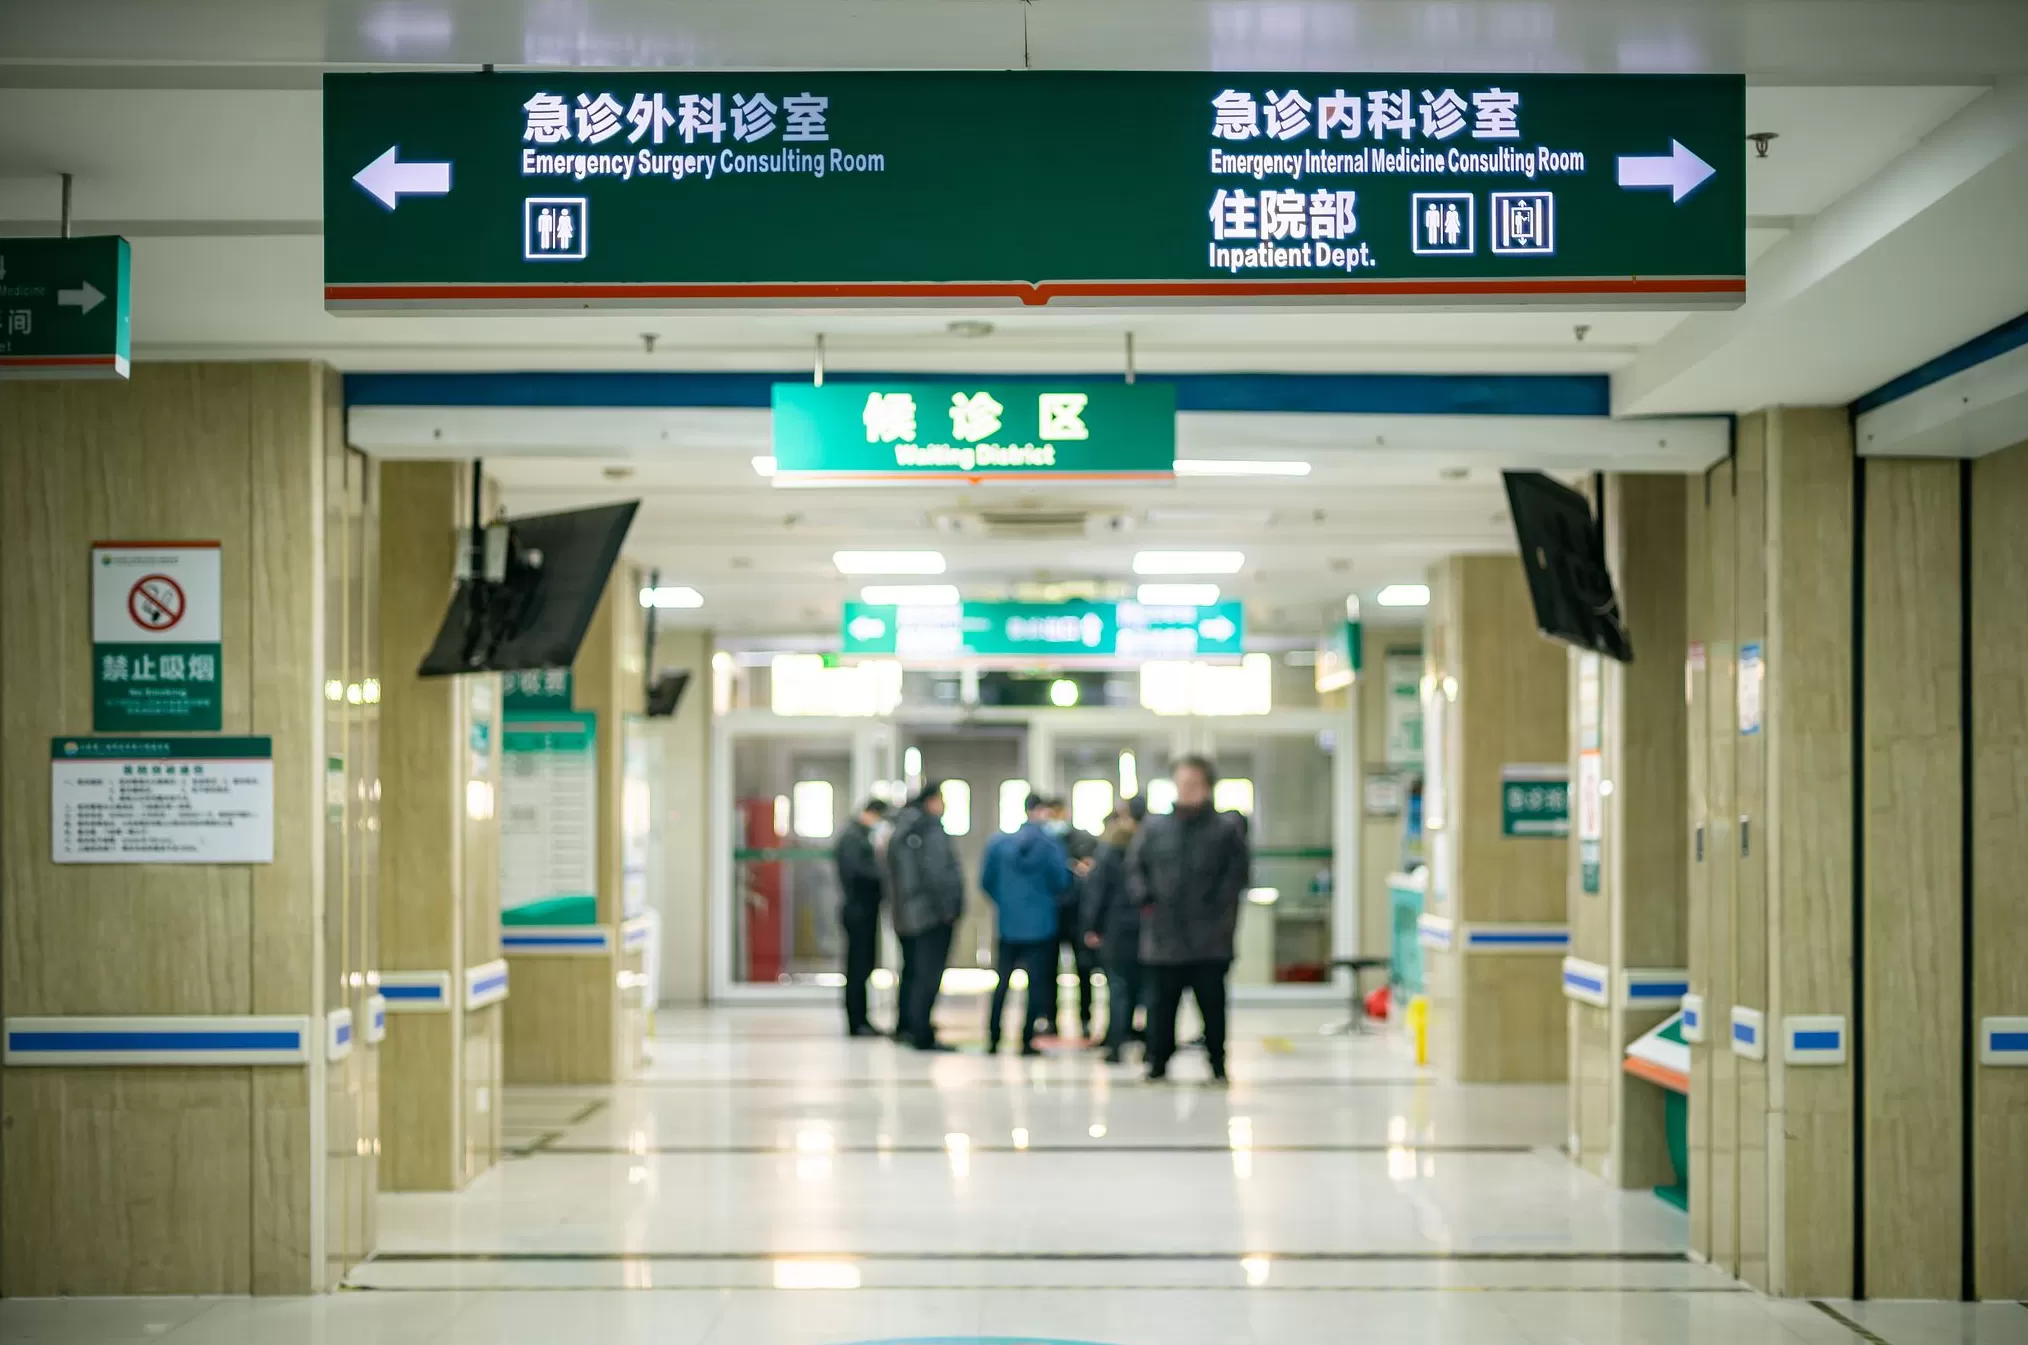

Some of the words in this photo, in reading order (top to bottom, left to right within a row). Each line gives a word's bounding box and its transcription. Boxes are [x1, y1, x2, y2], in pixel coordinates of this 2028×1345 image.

[522, 92, 830, 145] 急诊外科诊室
[1211, 87, 1521, 141] 急诊内科诊室
[521, 148, 635, 180] Emergency
[638, 148, 717, 180] Surgery
[720, 148, 825, 178] Consulting
[830, 148, 885, 172] Room
[1210, 148, 1303, 180] Emergency
[1305, 147, 1369, 174] Internal
[1371, 146, 1446, 174] Medicine
[1448, 146, 1536, 178] Consulting
[1538, 146, 1586, 172] Room
[1208, 188, 1358, 241] 住院部
[1208, 241, 1312, 273] Inpatient
[1315, 242, 1377, 273] Dept.
[863, 391, 1090, 443] 候诊区
[975, 442, 1056, 467] District
[102, 652, 215, 682] 禁止吸烟
